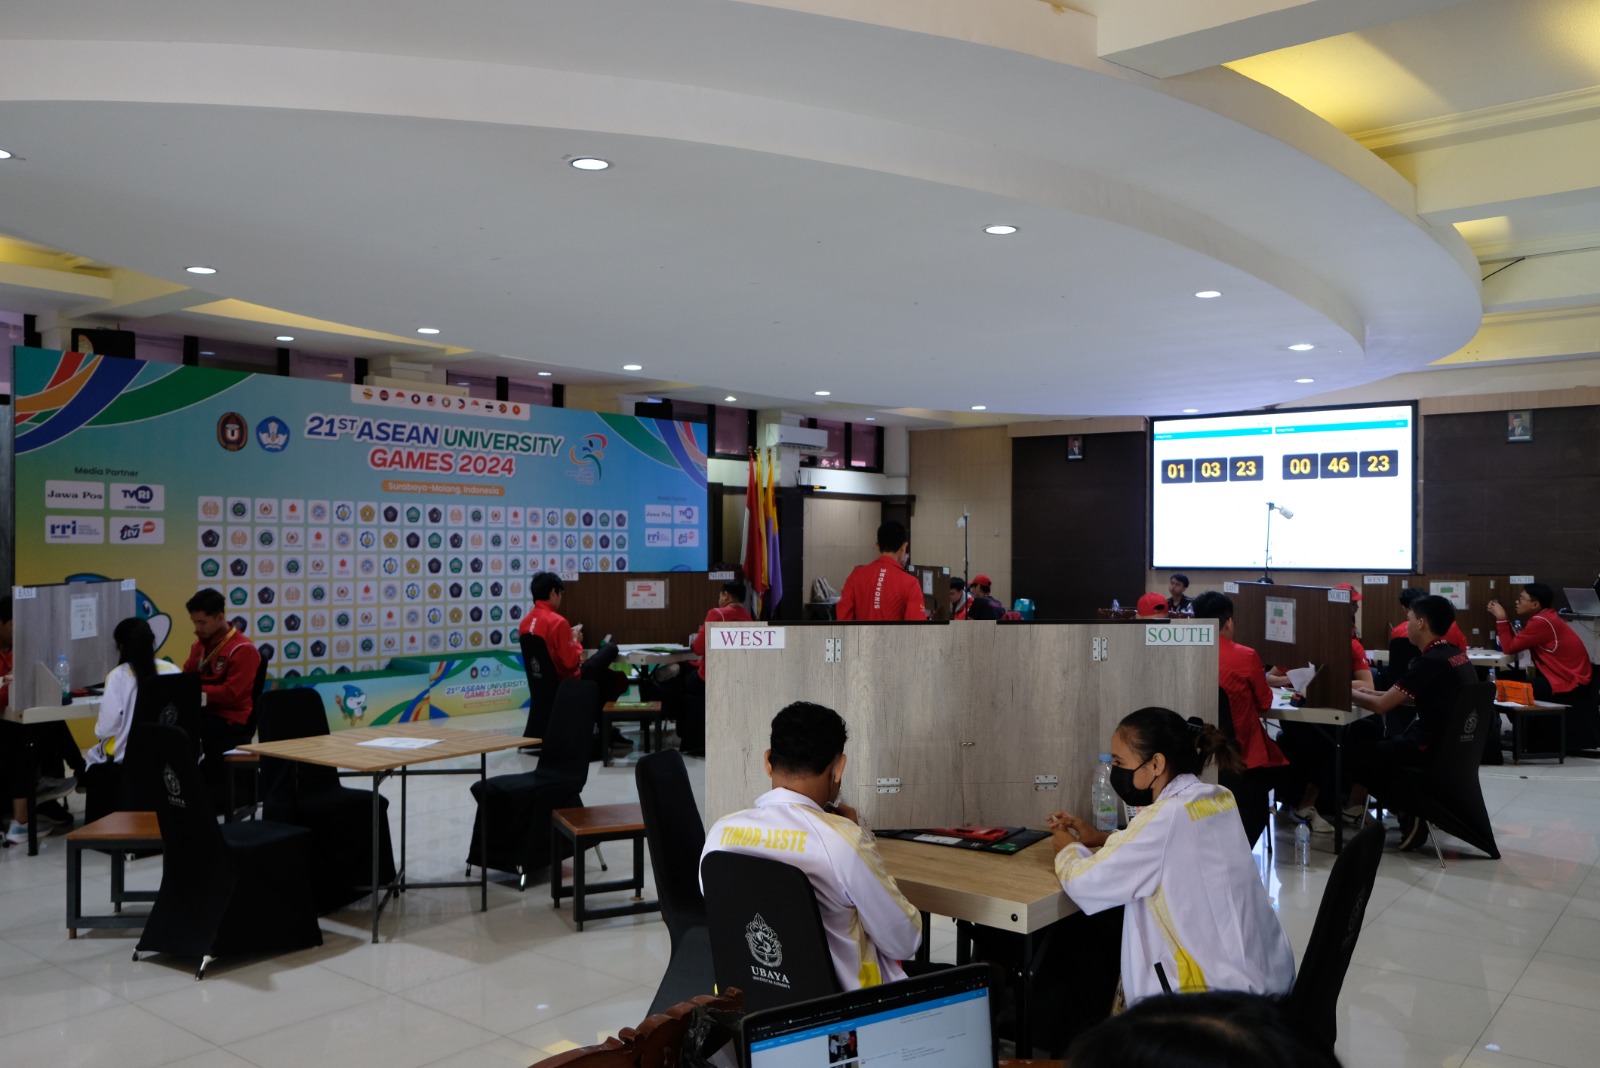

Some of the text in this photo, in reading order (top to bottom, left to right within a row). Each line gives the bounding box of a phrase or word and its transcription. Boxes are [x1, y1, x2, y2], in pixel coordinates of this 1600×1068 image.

[306, 415, 563, 453] 21ST ASEAN UNIVERSITY
[369, 449, 515, 476] GAMES 2024
[1167, 460, 1257, 479] 01 03 23
[1289, 455, 1390, 475] 00 46 23
[74, 467, 139, 477] Media Partner
[47, 490, 103, 500] Jawa Pos
[121, 487, 152, 502] TVRI
[463, 485, 499, 495] Indonesia
[50, 520, 77, 535] rri
[1366, 575, 1386, 583] WEST
[873, 567, 887, 609] SINGAPORE
[1328, 589, 1350, 601] NORTH
[719, 630, 777, 646] WEST
[1147, 627, 1212, 643] SOUTH
[460, 684, 486, 693] ASEAN
[487, 680, 527, 690] UNIVERSITY
[464, 688, 511, 699] GAMES 2024
[719, 826, 808, 853] TIMOR-LESTE
[750, 965, 790, 984] UBAYA
